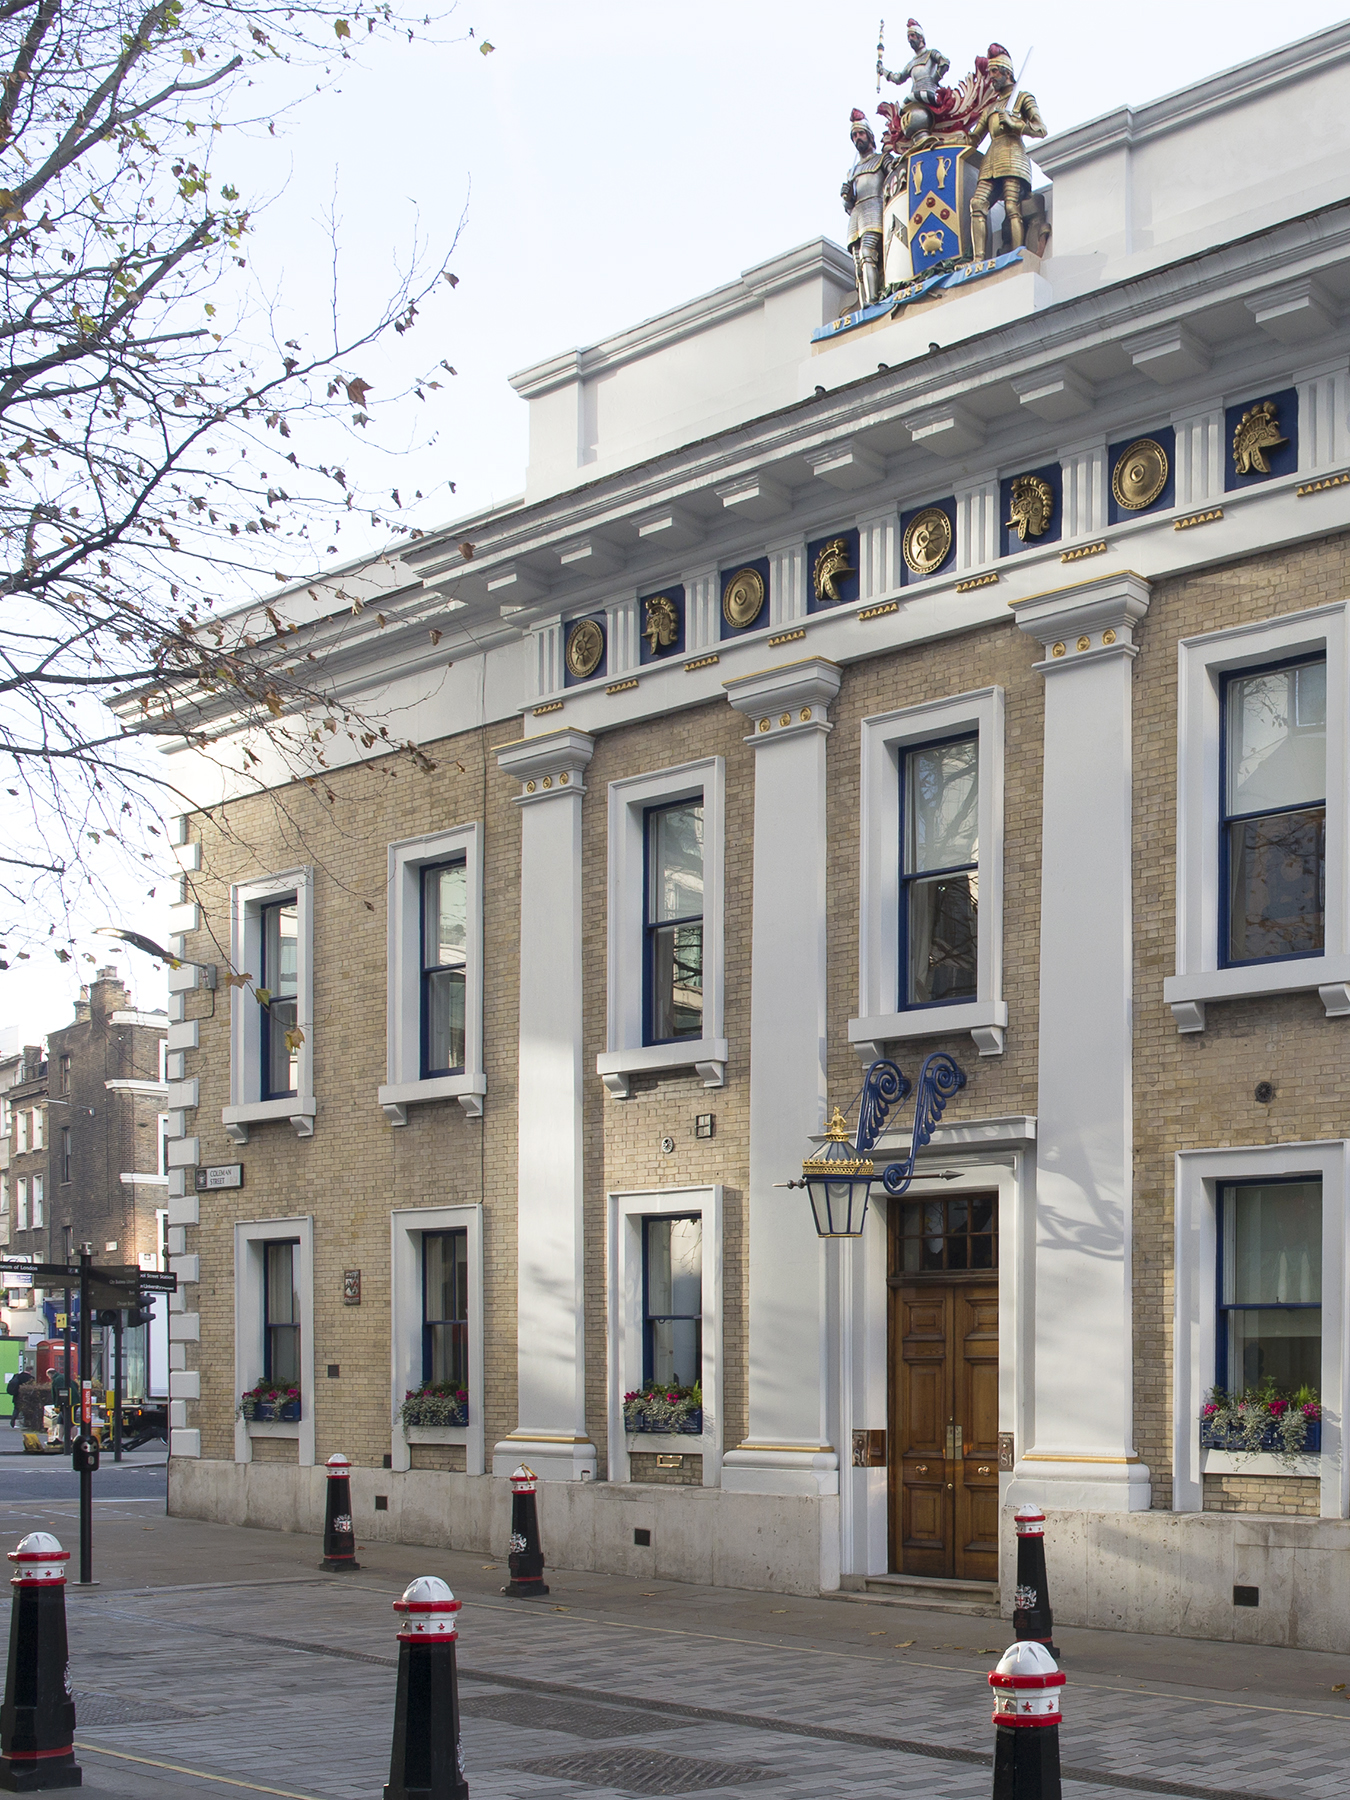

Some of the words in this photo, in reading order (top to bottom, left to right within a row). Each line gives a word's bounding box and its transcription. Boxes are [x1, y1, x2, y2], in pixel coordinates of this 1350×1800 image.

[832, 315, 852, 331] WE
[893, 283, 923, 300] ARE
[965, 260, 996, 276] ONE
[210, 1169, 232, 1178] COLEMAN
[210, 1178, 225, 1186] STREET
[853, 1448, 865, 1463] 81
[1000, 1452, 1013, 1467] 81
